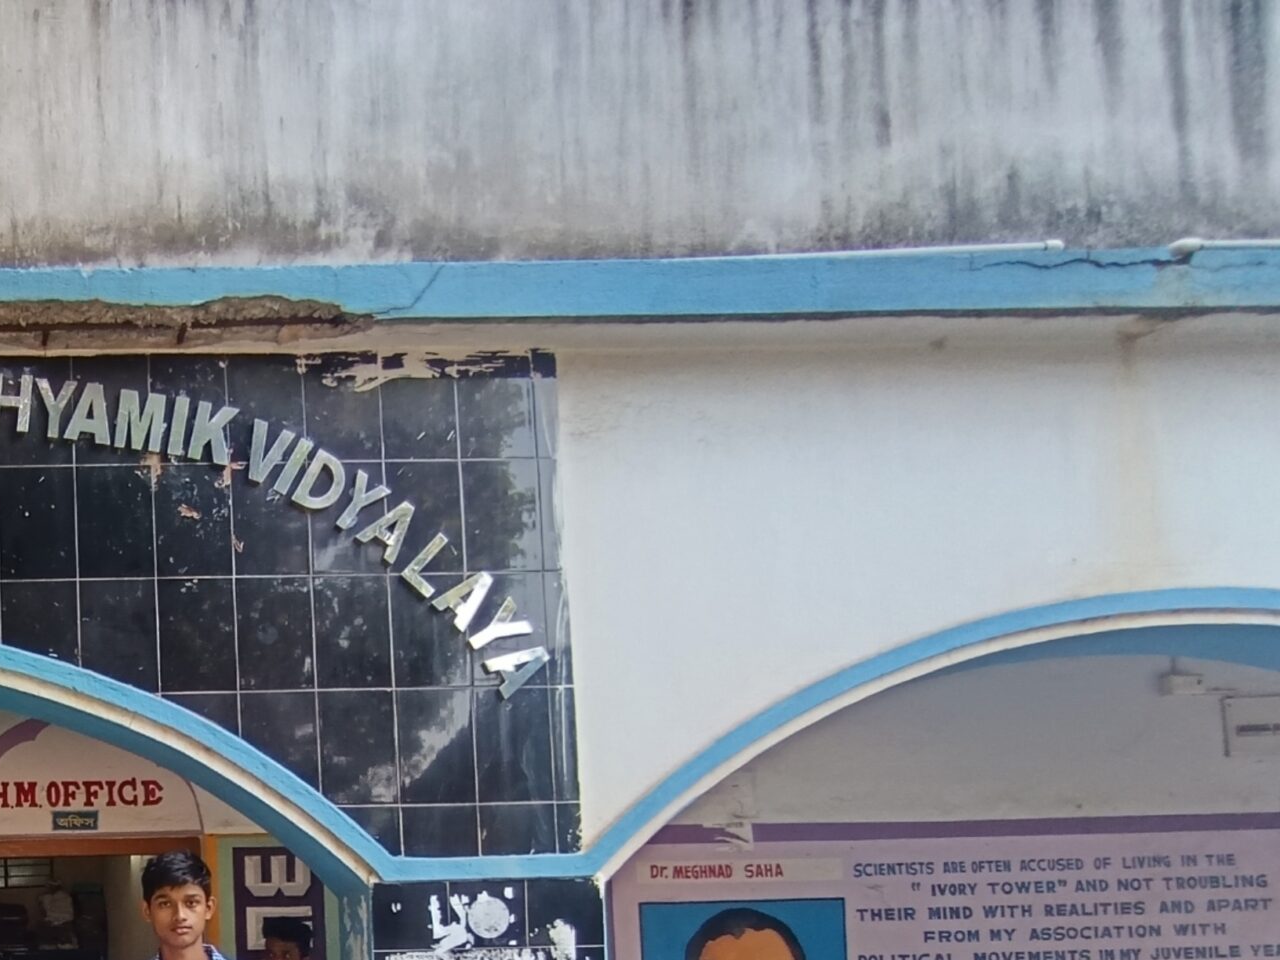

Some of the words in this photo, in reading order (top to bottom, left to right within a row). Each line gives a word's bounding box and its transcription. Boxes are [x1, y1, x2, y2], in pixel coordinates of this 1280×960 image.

[248, 418, 551, 700] VIDYALAYA
[49, 777, 164, 808] OFFICE
[55, 814, 96, 828] অফিস
[650, 864, 668, 879] Dr.
[672, 863, 733, 879] MEGHNAD
[744, 863, 784, 878] SAHA
[853, 862, 934, 877] SCIENTISTS
[943, 861, 966, 874] ARE
[971, 860, 1011, 873] OFTEN
[1020, 858, 1084, 872] ACCUSED
[1094, 857, 1111, 870] OF
[1122, 855, 1171, 869] LIVING
[1181, 854, 1197, 867] IN
[1205, 854, 1236, 866] THE
[1075, 879, 1108, 893] AND
[1117, 878, 1154, 891] NOT
[1162, 874, 1268, 890] TROUBLING
[856, 907, 916, 921] THEIR
[928, 906, 973, 920] MIND
[983, 904, 1033, 918] WITH
[1045, 901, 1146, 917] REALITIES
[1160, 900, 1195, 914] AND
[1206, 898, 1272, 912] APART
[923, 929, 980, 943] FROM
[990, 928, 1016, 941] MY
[1029, 925, 1161, 941] ASSOCIATION
[1173, 923, 1226, 936] WITH
[1120, 948, 1142, 960] MY
[1150, 945, 1242, 960] JUVENILE
